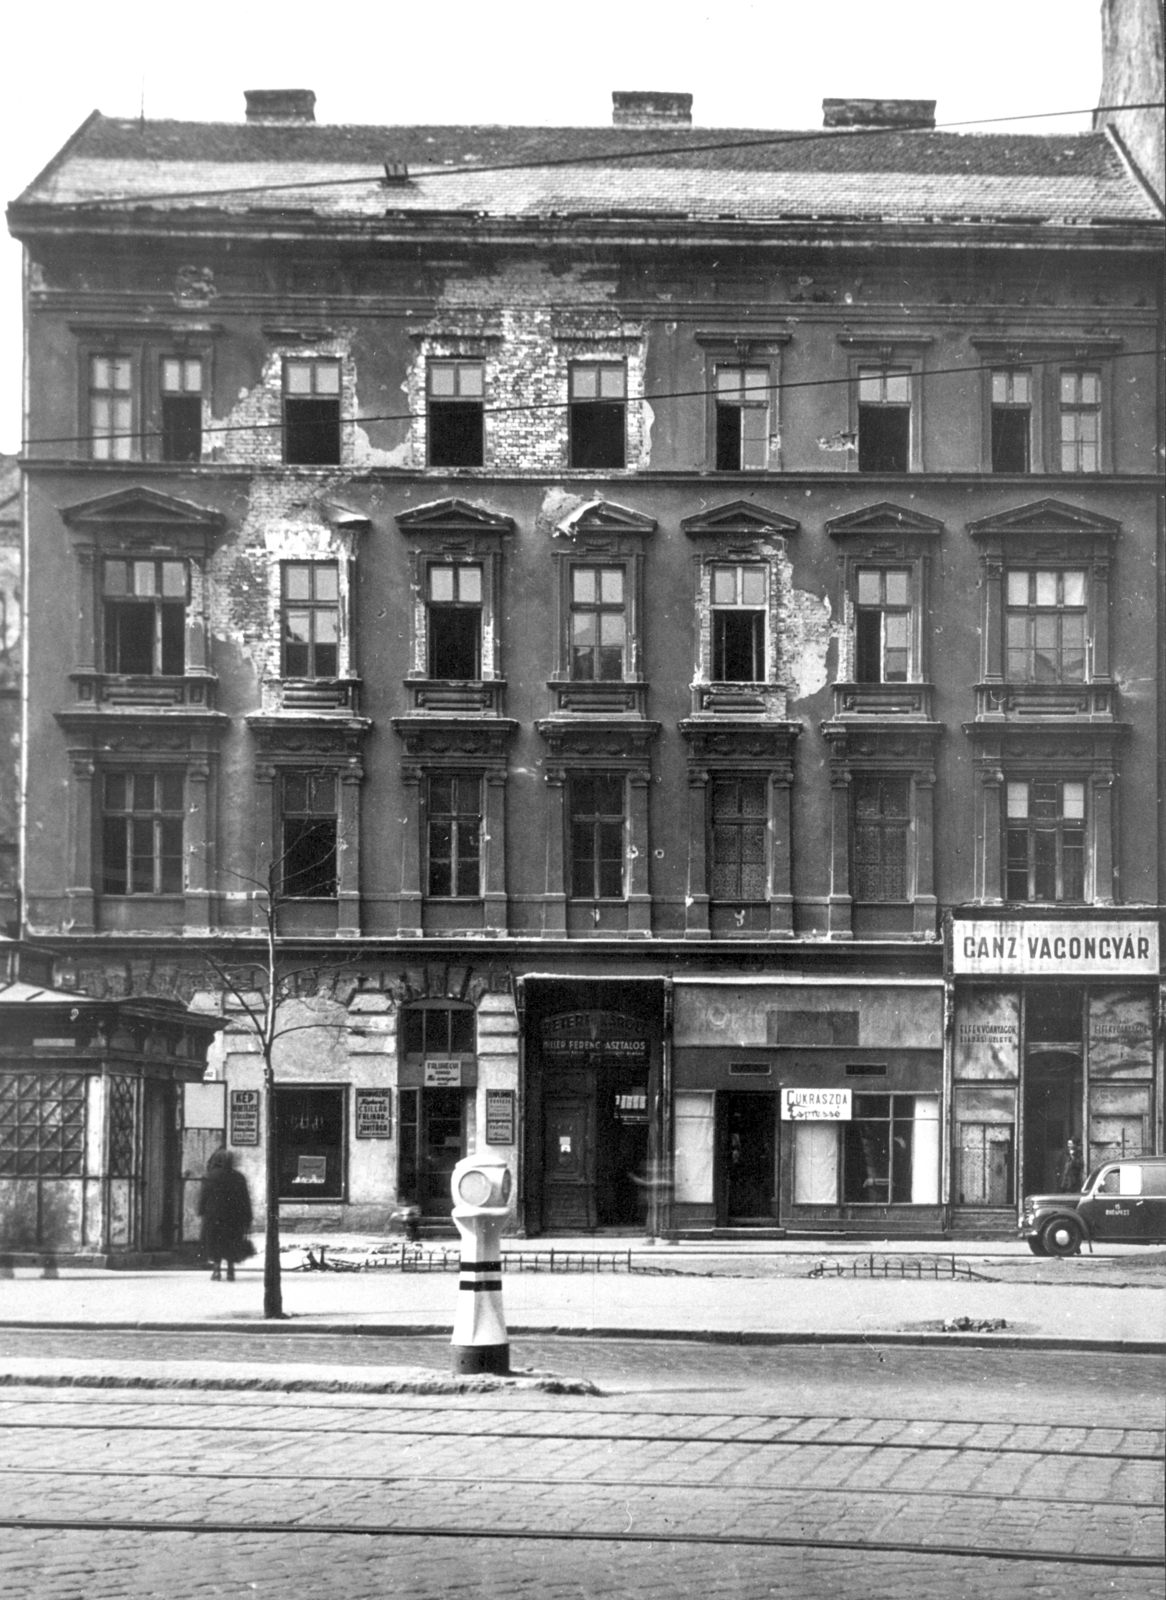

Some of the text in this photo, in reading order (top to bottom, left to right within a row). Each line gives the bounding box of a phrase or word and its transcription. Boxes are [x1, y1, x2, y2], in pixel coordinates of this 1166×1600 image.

[963, 932, 1150, 960] GANZ VAGONGYÁR
[569, 1040, 601, 1050] FERENC
[605, 1041, 647, 1051] ASZTALOS
